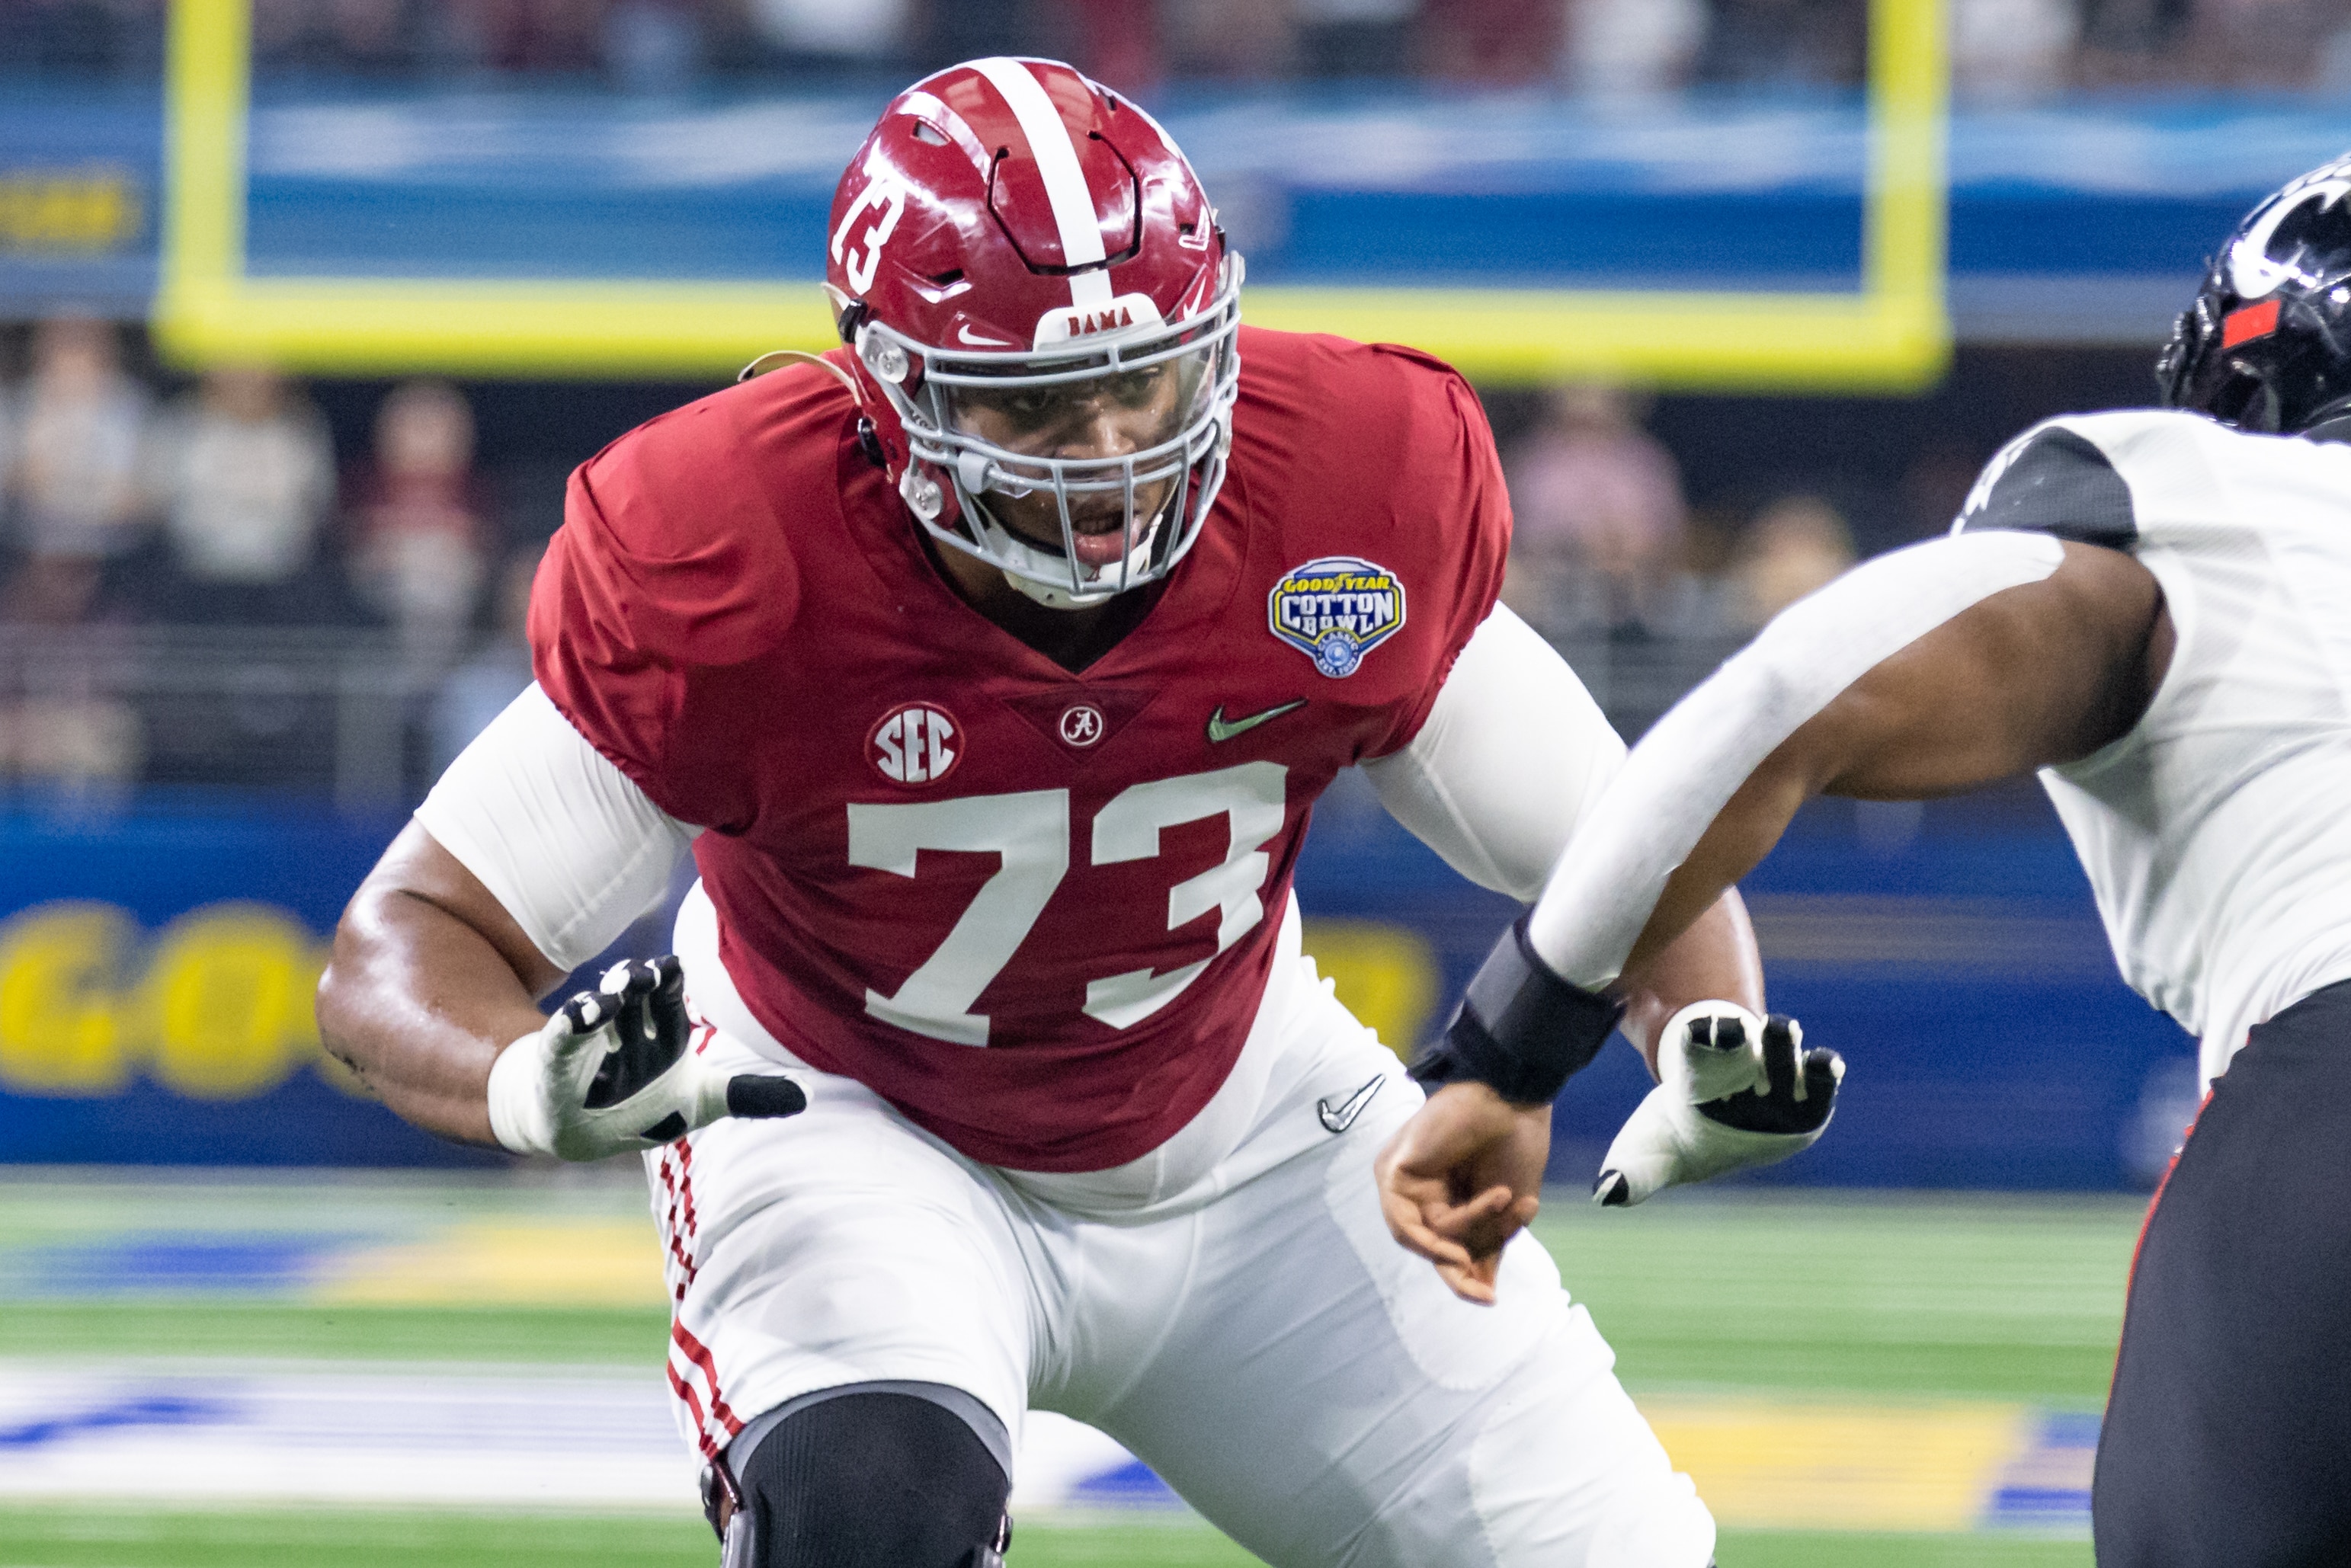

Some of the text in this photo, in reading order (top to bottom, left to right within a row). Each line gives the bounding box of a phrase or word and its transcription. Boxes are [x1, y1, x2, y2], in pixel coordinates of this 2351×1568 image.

[831, 136, 906, 296] 73
[1068, 306, 1134, 337] BAMA
[1281, 592, 1394, 631] COTTON
[1302, 615, 1373, 637] BOWL
[876, 709, 955, 782] SEC
[847, 760, 1289, 1048] 73
